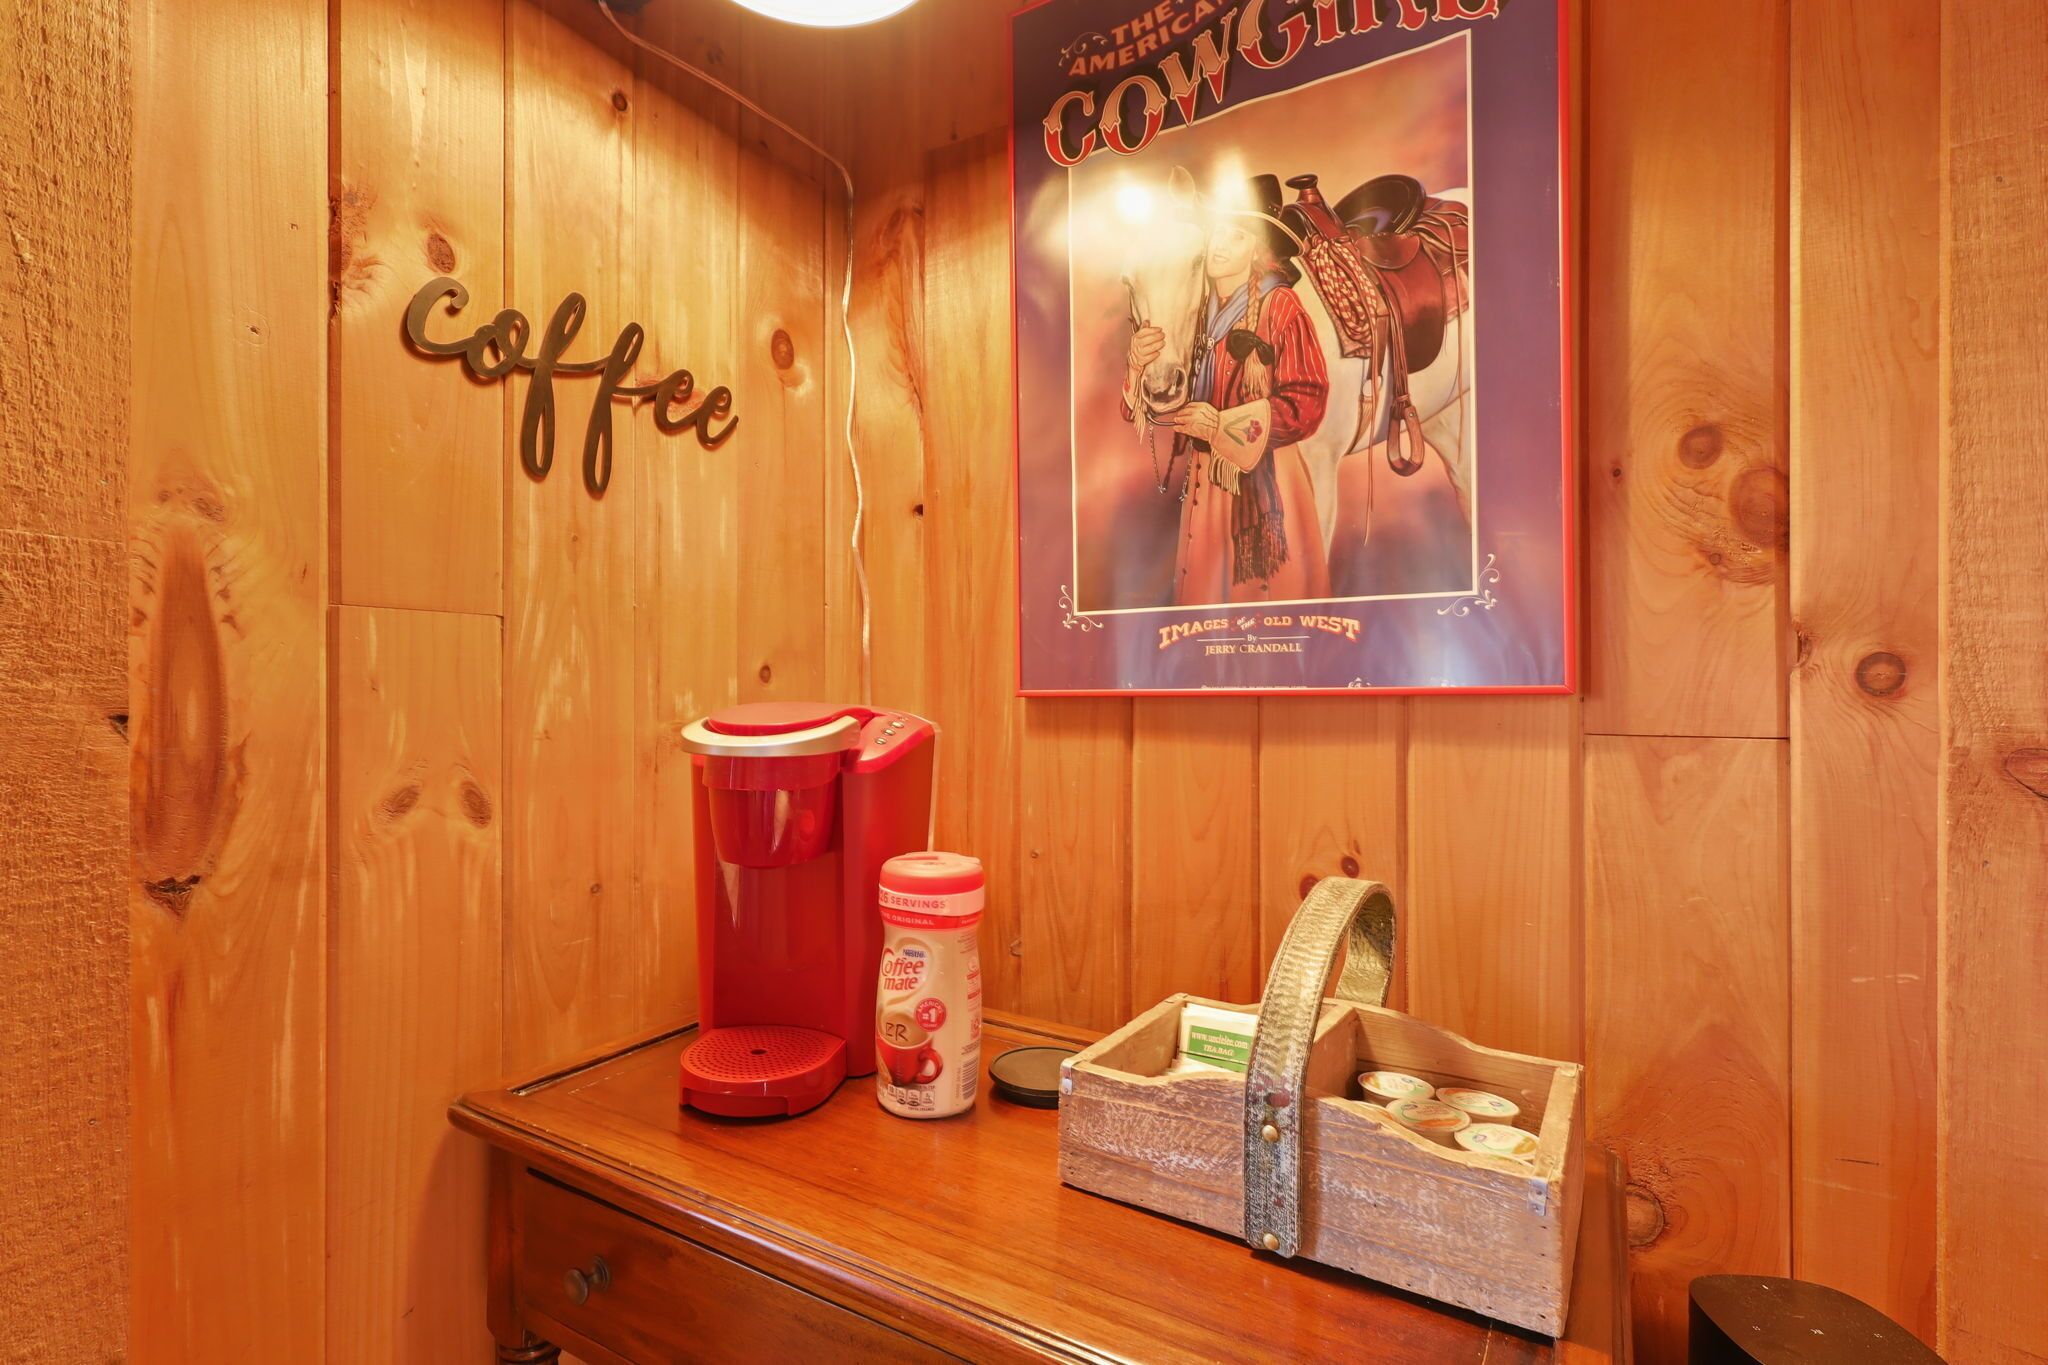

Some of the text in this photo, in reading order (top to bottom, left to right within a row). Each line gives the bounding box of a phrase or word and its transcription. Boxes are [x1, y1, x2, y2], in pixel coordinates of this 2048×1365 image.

[1111, 0, 1175, 45] THE
[1068, 0, 1230, 76] AMERICA
[403, 276, 740, 498] coffee
[1159, 618, 1229, 650] IMAGES
[1263, 616, 1293, 627] OLD
[1299, 615, 1361, 643] WEST
[1247, 634, 1257, 643] By
[1204, 642, 1303, 657] JERRY CRANDALL
[890, 895, 946, 909] SERVINGS
[891, 914, 934, 926] ORIGINAL
[882, 947, 924, 977] Coffee
[883, 976, 919, 991] mate
[1203, 1044, 1234, 1056] TEA BAG
